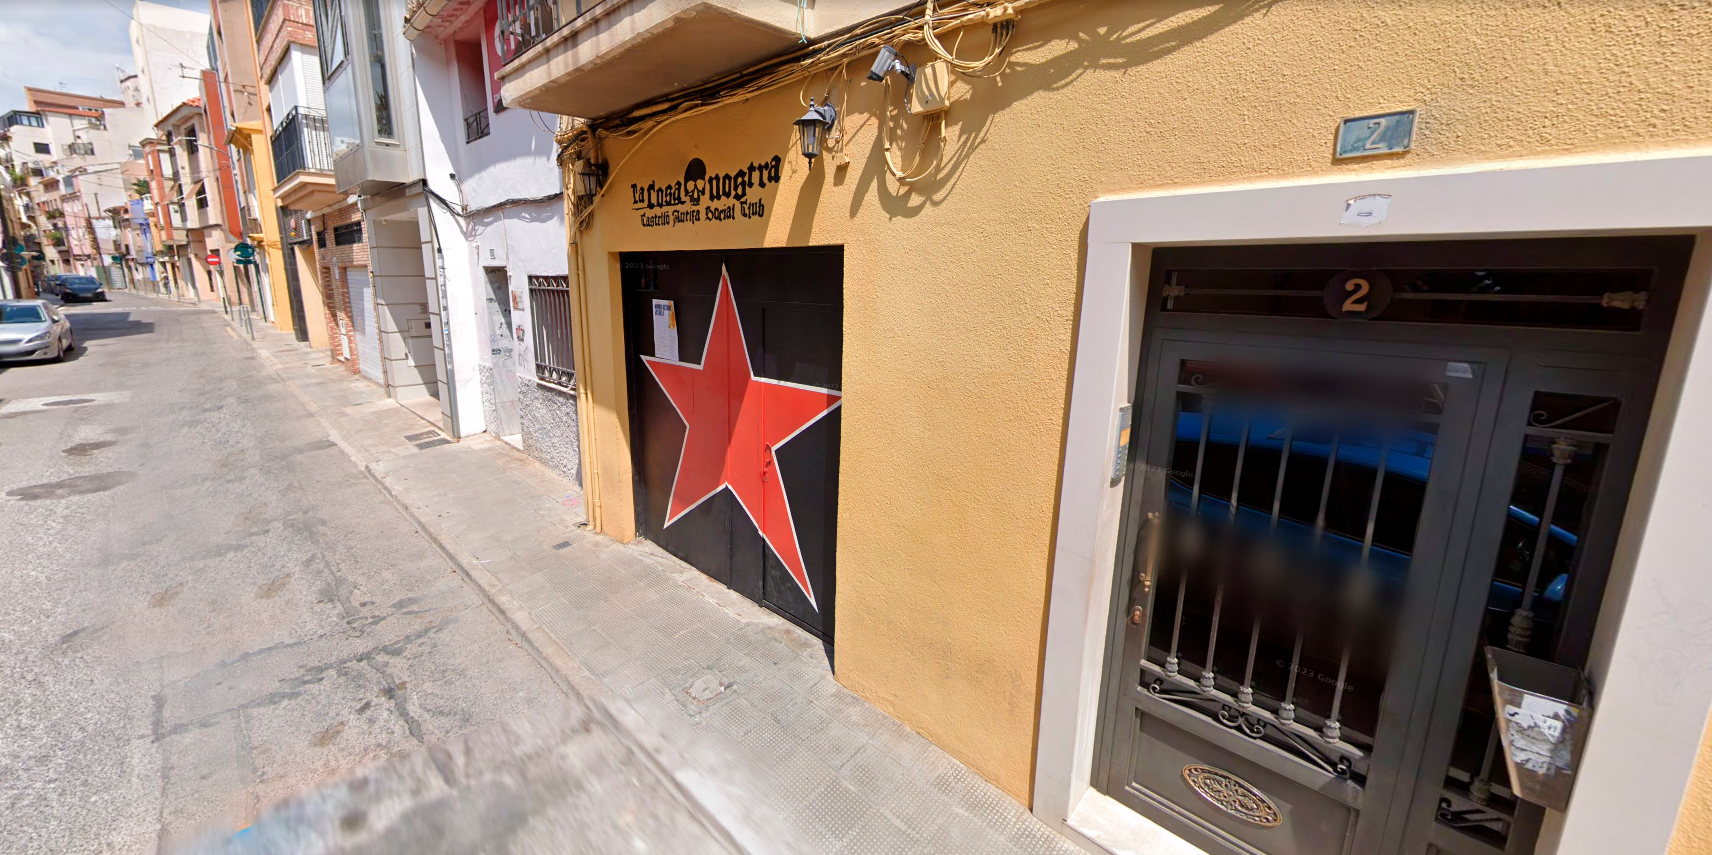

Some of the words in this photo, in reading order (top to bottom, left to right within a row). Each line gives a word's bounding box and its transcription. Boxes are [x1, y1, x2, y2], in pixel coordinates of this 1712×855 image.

[1364, 118, 1387, 151] 2
[708, 155, 782, 202] nostra
[672, 207, 700, 228] Antifa
[705, 203, 736, 222] Social
[739, 197, 765, 219] Club
[1342, 278, 1370, 312] 2
